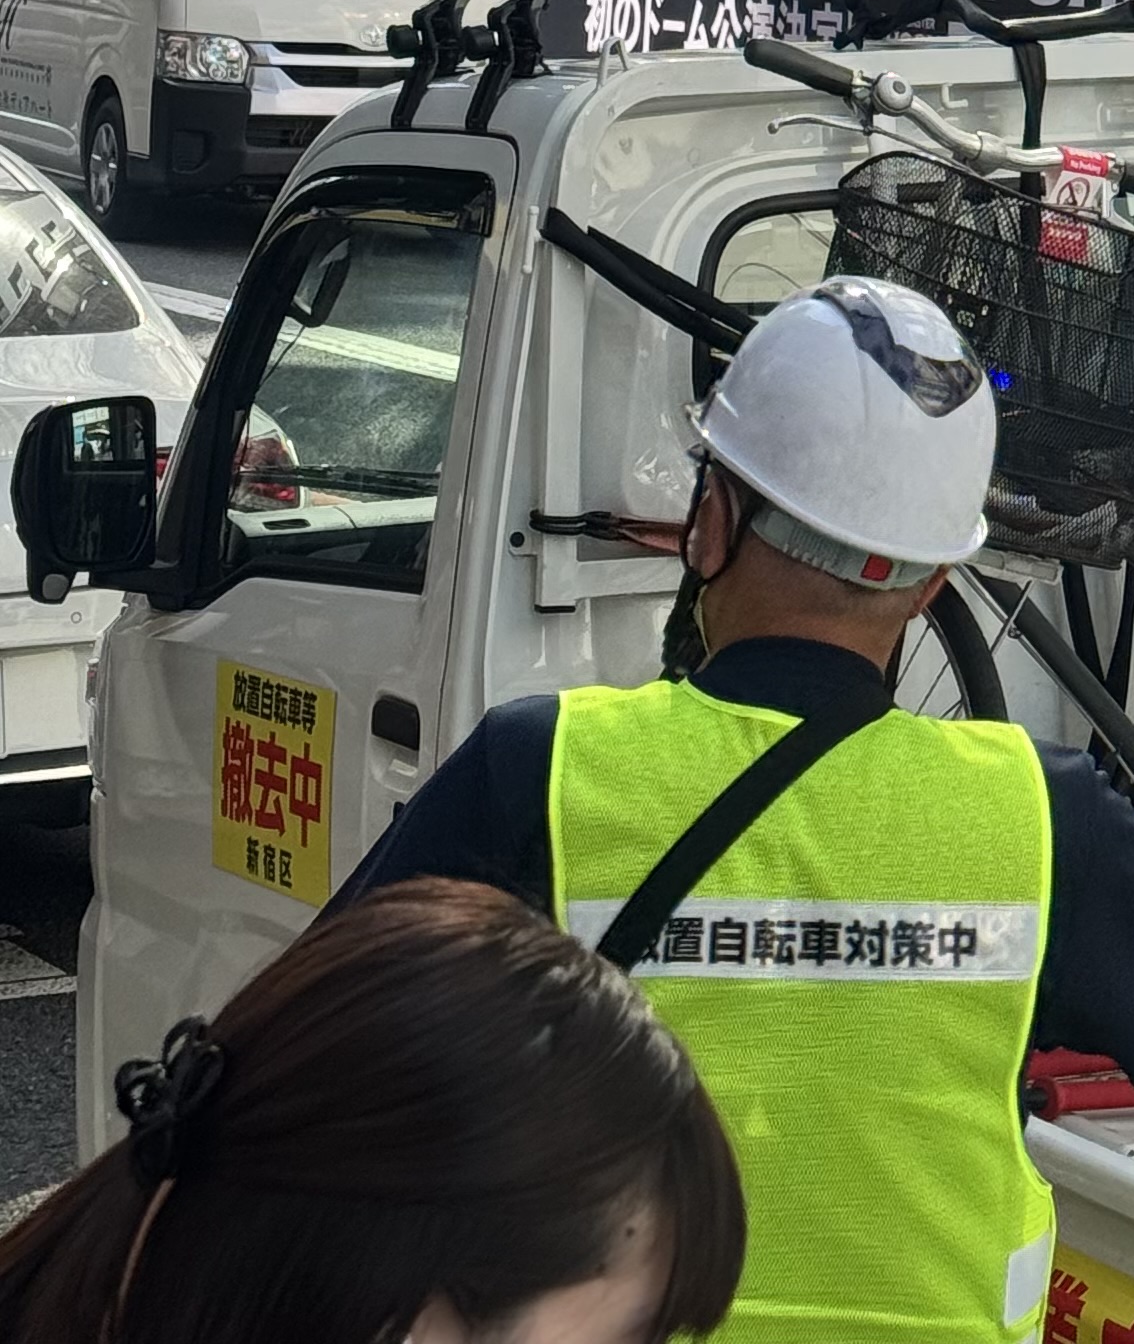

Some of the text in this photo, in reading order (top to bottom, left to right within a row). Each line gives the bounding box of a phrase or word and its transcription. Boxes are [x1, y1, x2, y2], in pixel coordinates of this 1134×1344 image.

[233, 669, 318, 736] 放置自転車等
[221, 715, 323, 849] 撤去中
[247, 835, 293, 890] 新宿区
